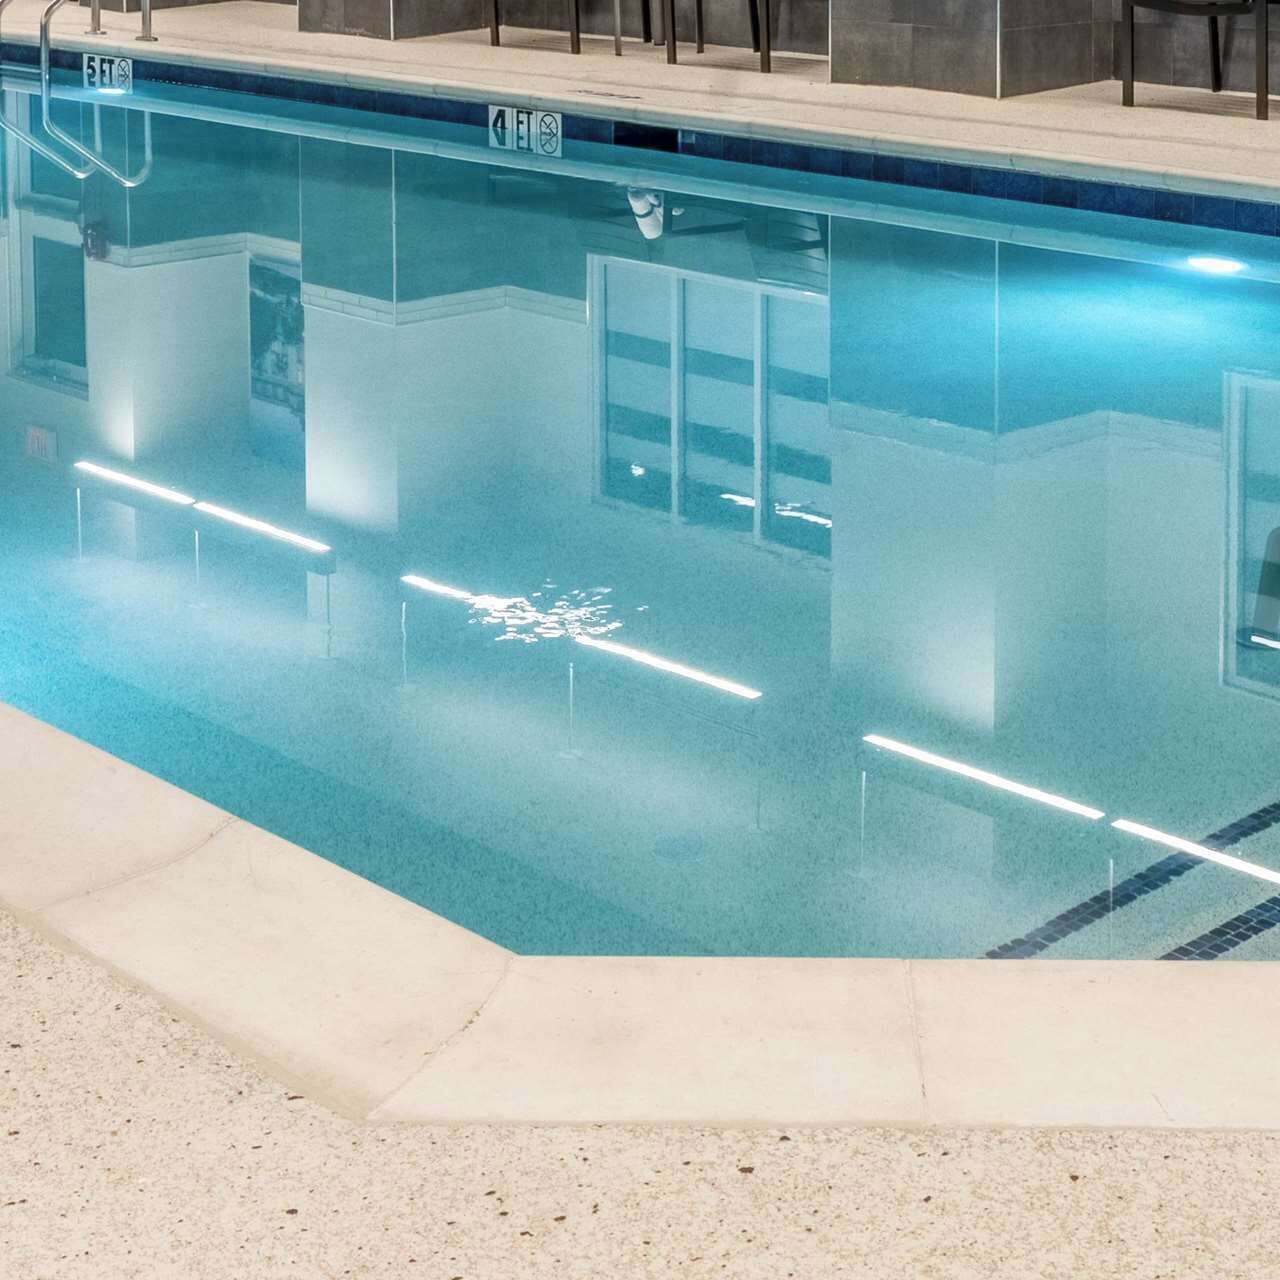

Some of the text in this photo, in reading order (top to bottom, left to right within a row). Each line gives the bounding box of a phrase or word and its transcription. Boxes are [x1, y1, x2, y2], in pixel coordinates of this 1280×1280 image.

[100, 58, 115, 81] FT
[492, 109, 533, 136] 4 FT
